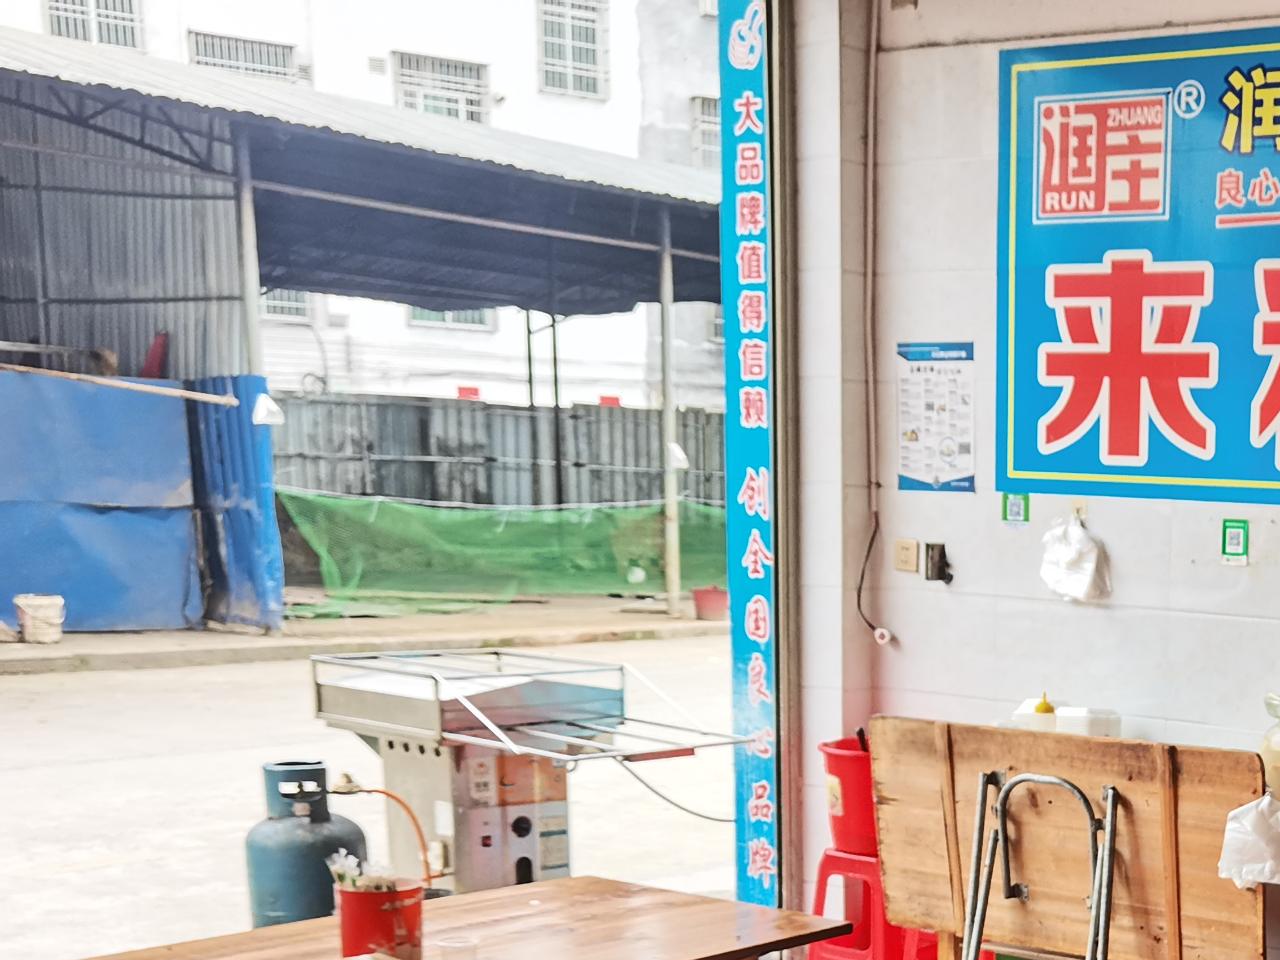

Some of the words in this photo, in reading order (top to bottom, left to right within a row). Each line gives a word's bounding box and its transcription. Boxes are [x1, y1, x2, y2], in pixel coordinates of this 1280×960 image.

[1107, 105, 1163, 127] ZHUANG
[1045, 191, 1096, 212] RUN
[734, 91, 767, 428] 大品牌值得信赖
